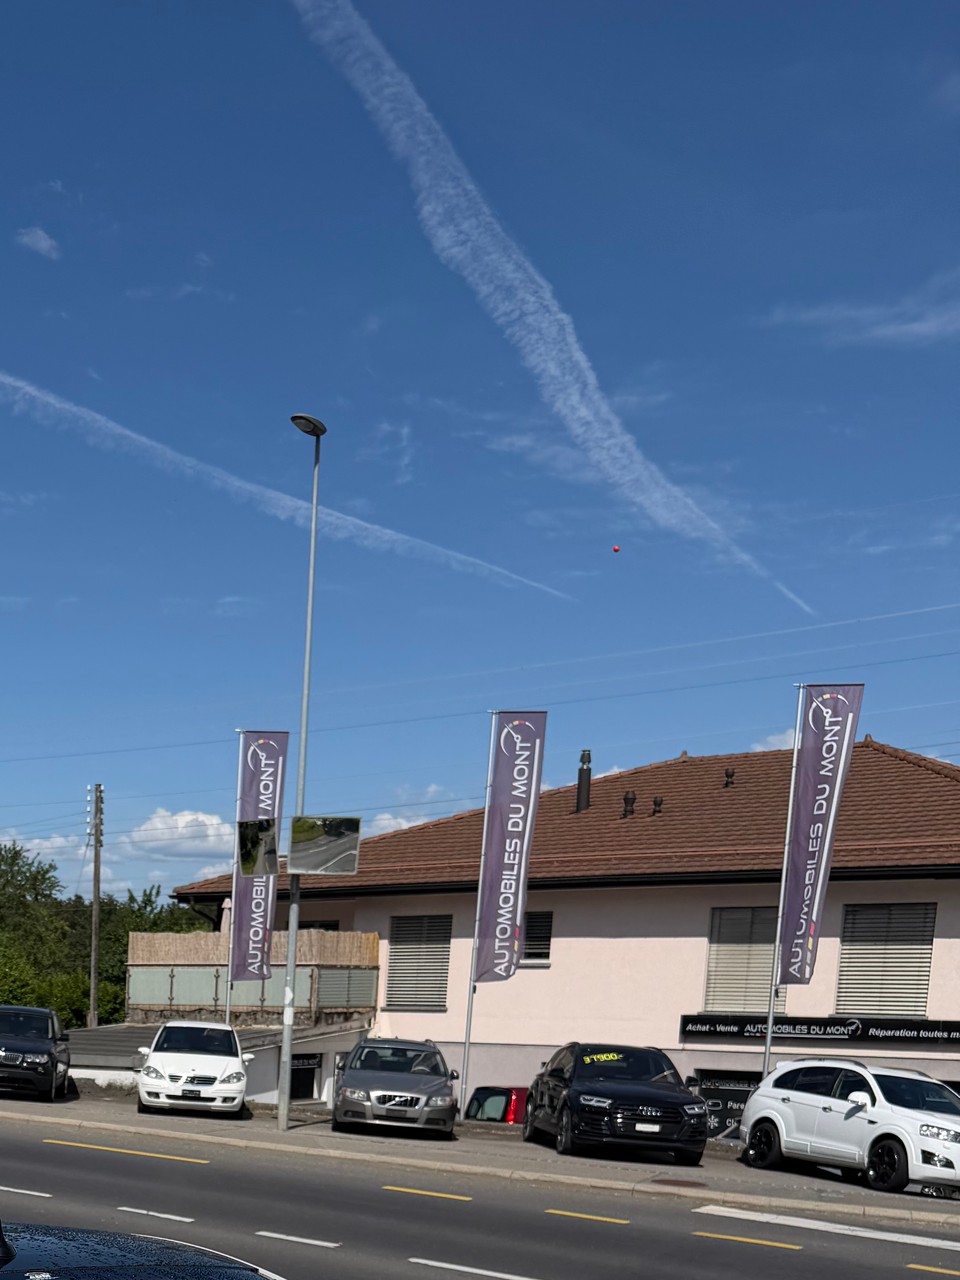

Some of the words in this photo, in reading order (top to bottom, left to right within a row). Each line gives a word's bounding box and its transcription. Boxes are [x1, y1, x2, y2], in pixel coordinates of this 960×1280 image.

[819, 715, 843, 776] MONT
[511, 741, 531, 798] MONT
[507, 804, 524, 832] DU
[813, 784, 830, 815] DU
[248, 875, 267, 975] AUTOMOBIL
[259, 758, 276, 814] MONT
[494, 839, 520, 977] AUTOMOBILES
[789, 822, 823, 978] AUTOMOBILES
[686, 1023, 709, 1032] Achat
[716, 1024, 738, 1032] Vente
[744, 1024, 808, 1035] AUTOMOBILES
[810, 1026, 823, 1035] DU
[825, 1026, 854, 1036] MONT
[868, 1027, 917, 1038] Réparation
[919, 1030, 948, 1039] toutes
